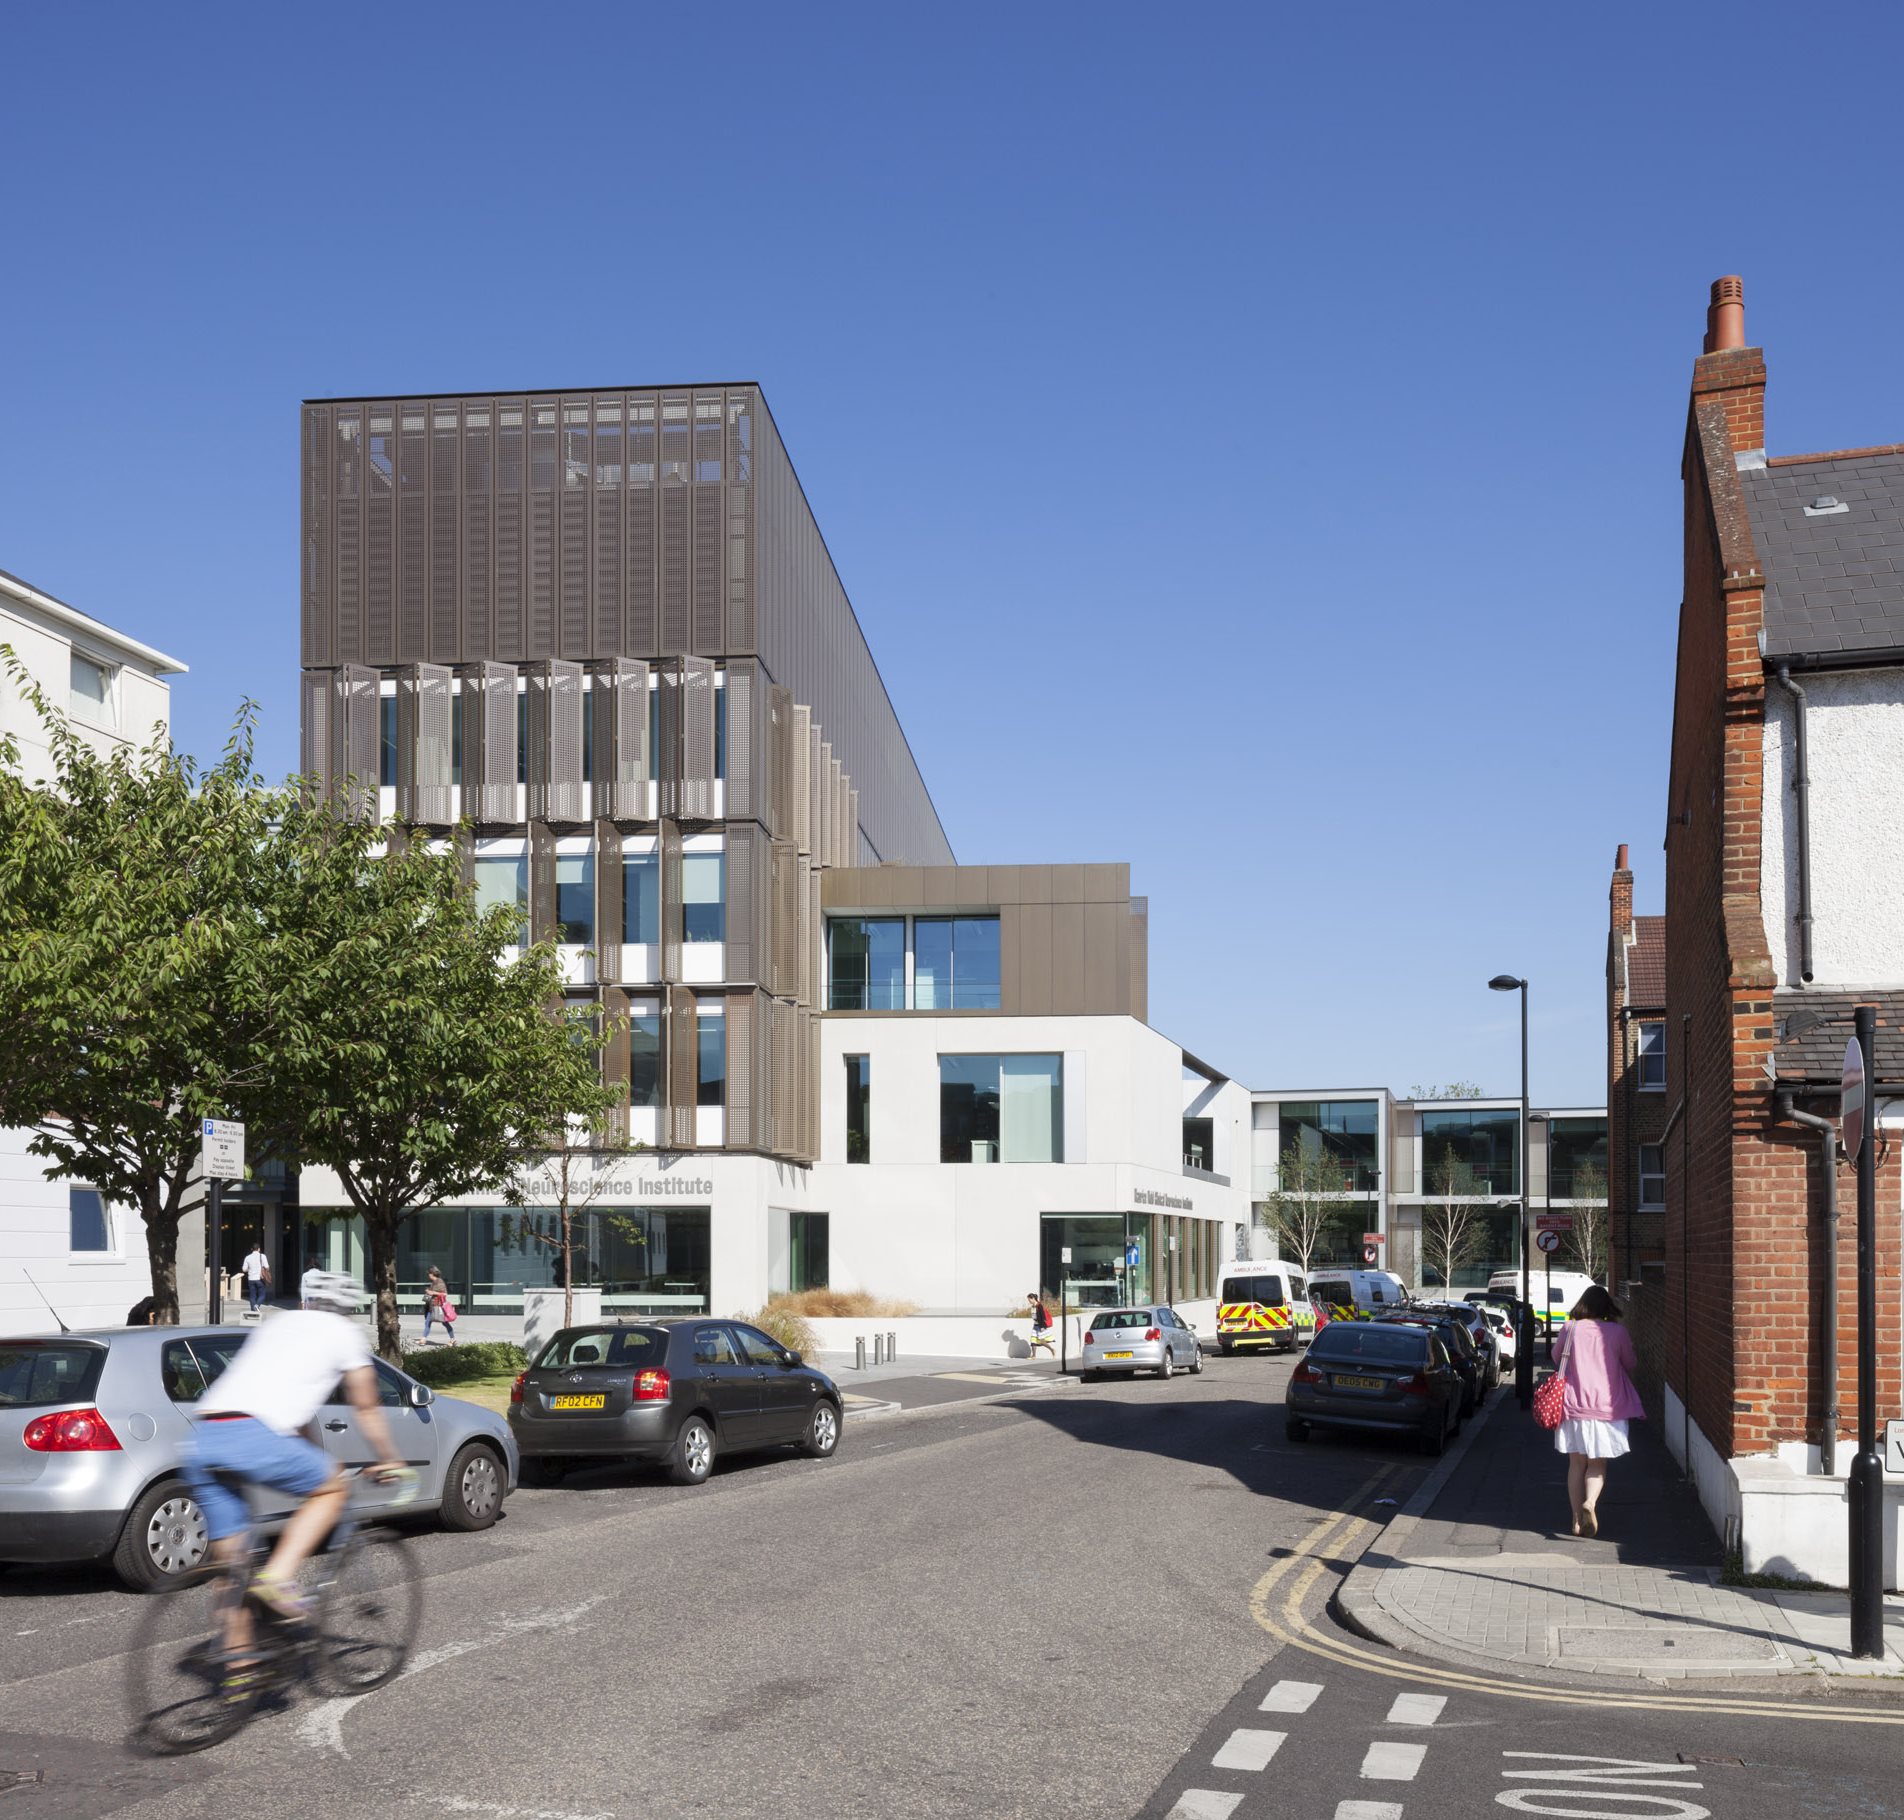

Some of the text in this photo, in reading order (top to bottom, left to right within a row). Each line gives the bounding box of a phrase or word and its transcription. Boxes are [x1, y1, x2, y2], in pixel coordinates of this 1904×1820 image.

[521, 1177, 632, 1195] Neurscince
[639, 1177, 713, 1195] Institute
[555, 1395, 603, 1407] RF02 CFN
